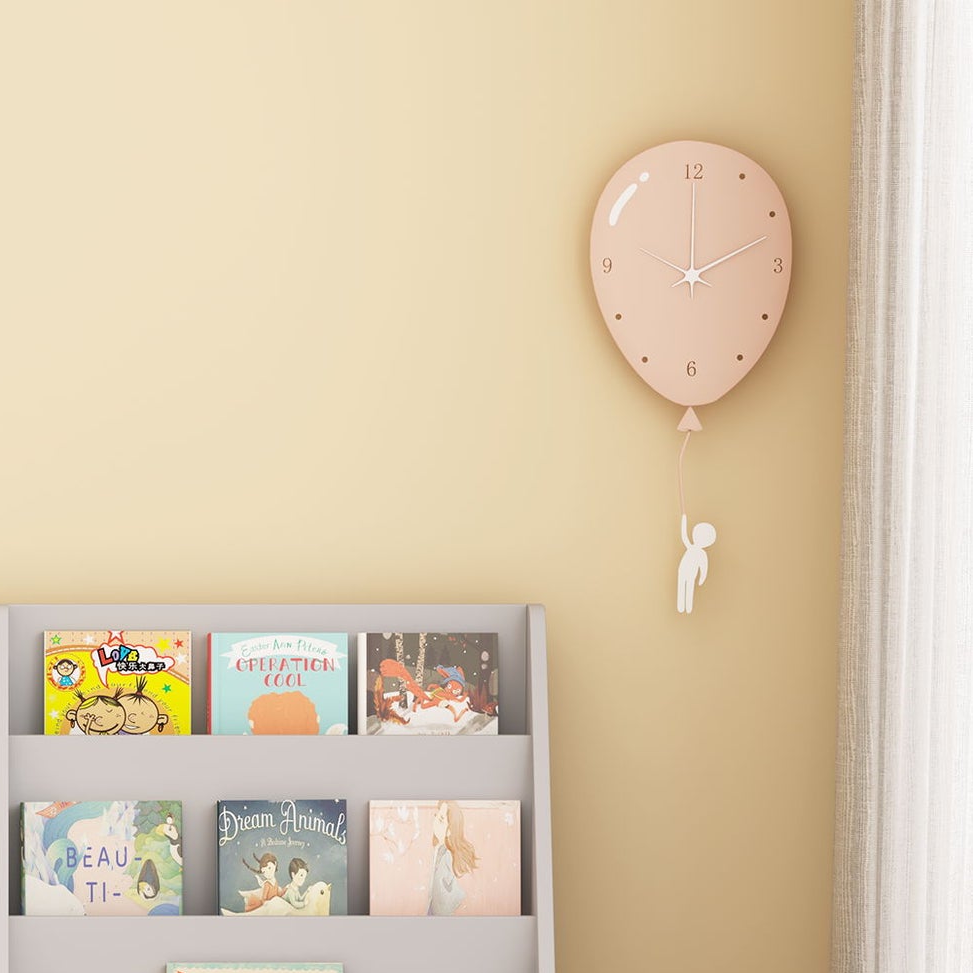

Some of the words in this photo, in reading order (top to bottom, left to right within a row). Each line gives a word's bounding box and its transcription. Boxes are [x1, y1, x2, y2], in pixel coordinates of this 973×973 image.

[684, 163, 704, 180] 12
[602, 257, 613, 274] 9
[773, 258, 784, 274] 3
[686, 361, 697, 377] 6
[235, 657, 335, 673] OPERATION
[263, 673, 307, 688] COOL
[218, 805, 277, 847] Dream
[279, 799, 347, 845] Animals
[86, 881, 121, 903] TI-
